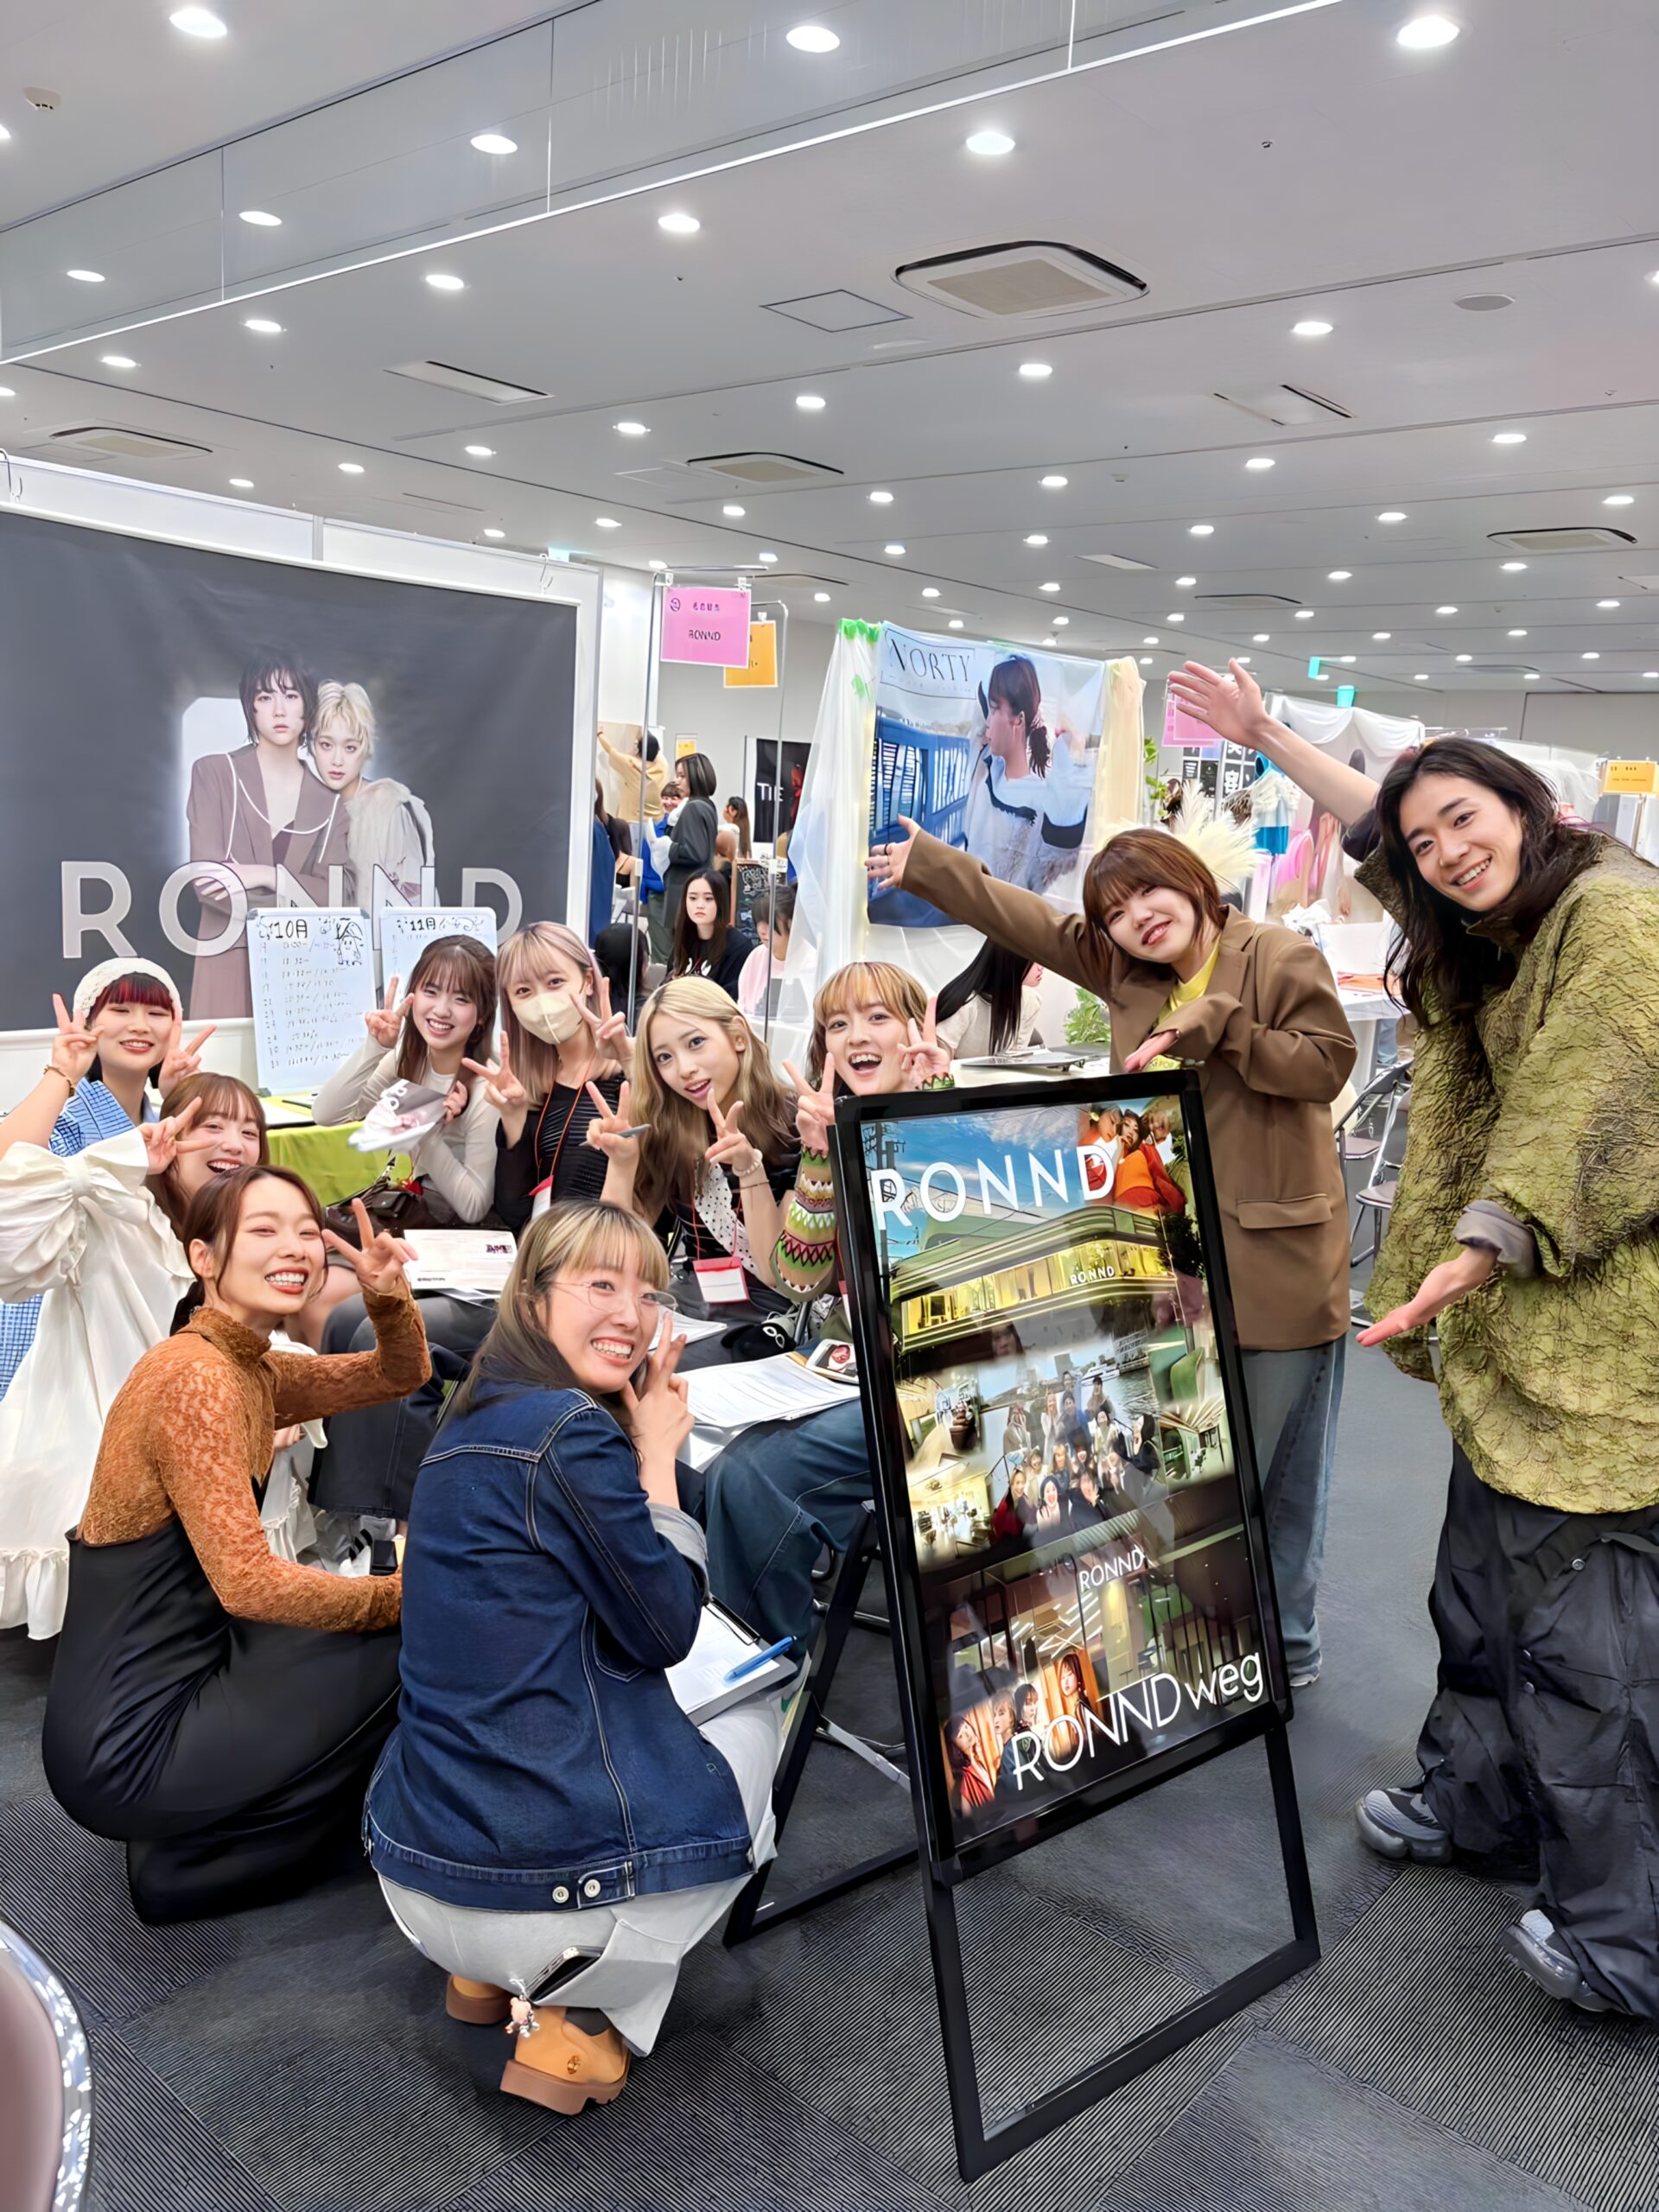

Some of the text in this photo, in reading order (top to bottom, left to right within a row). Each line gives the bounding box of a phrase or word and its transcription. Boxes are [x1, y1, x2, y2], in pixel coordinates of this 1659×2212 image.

[890, 639, 969, 682] NORTY
[274, 918, 308, 939] 10月
[410, 917, 436, 931] 11月
[871, 1145, 1115, 1230] RONND
[1070, 1266, 1115, 1286] RONND
[1079, 1548, 1146, 1592] RONND
